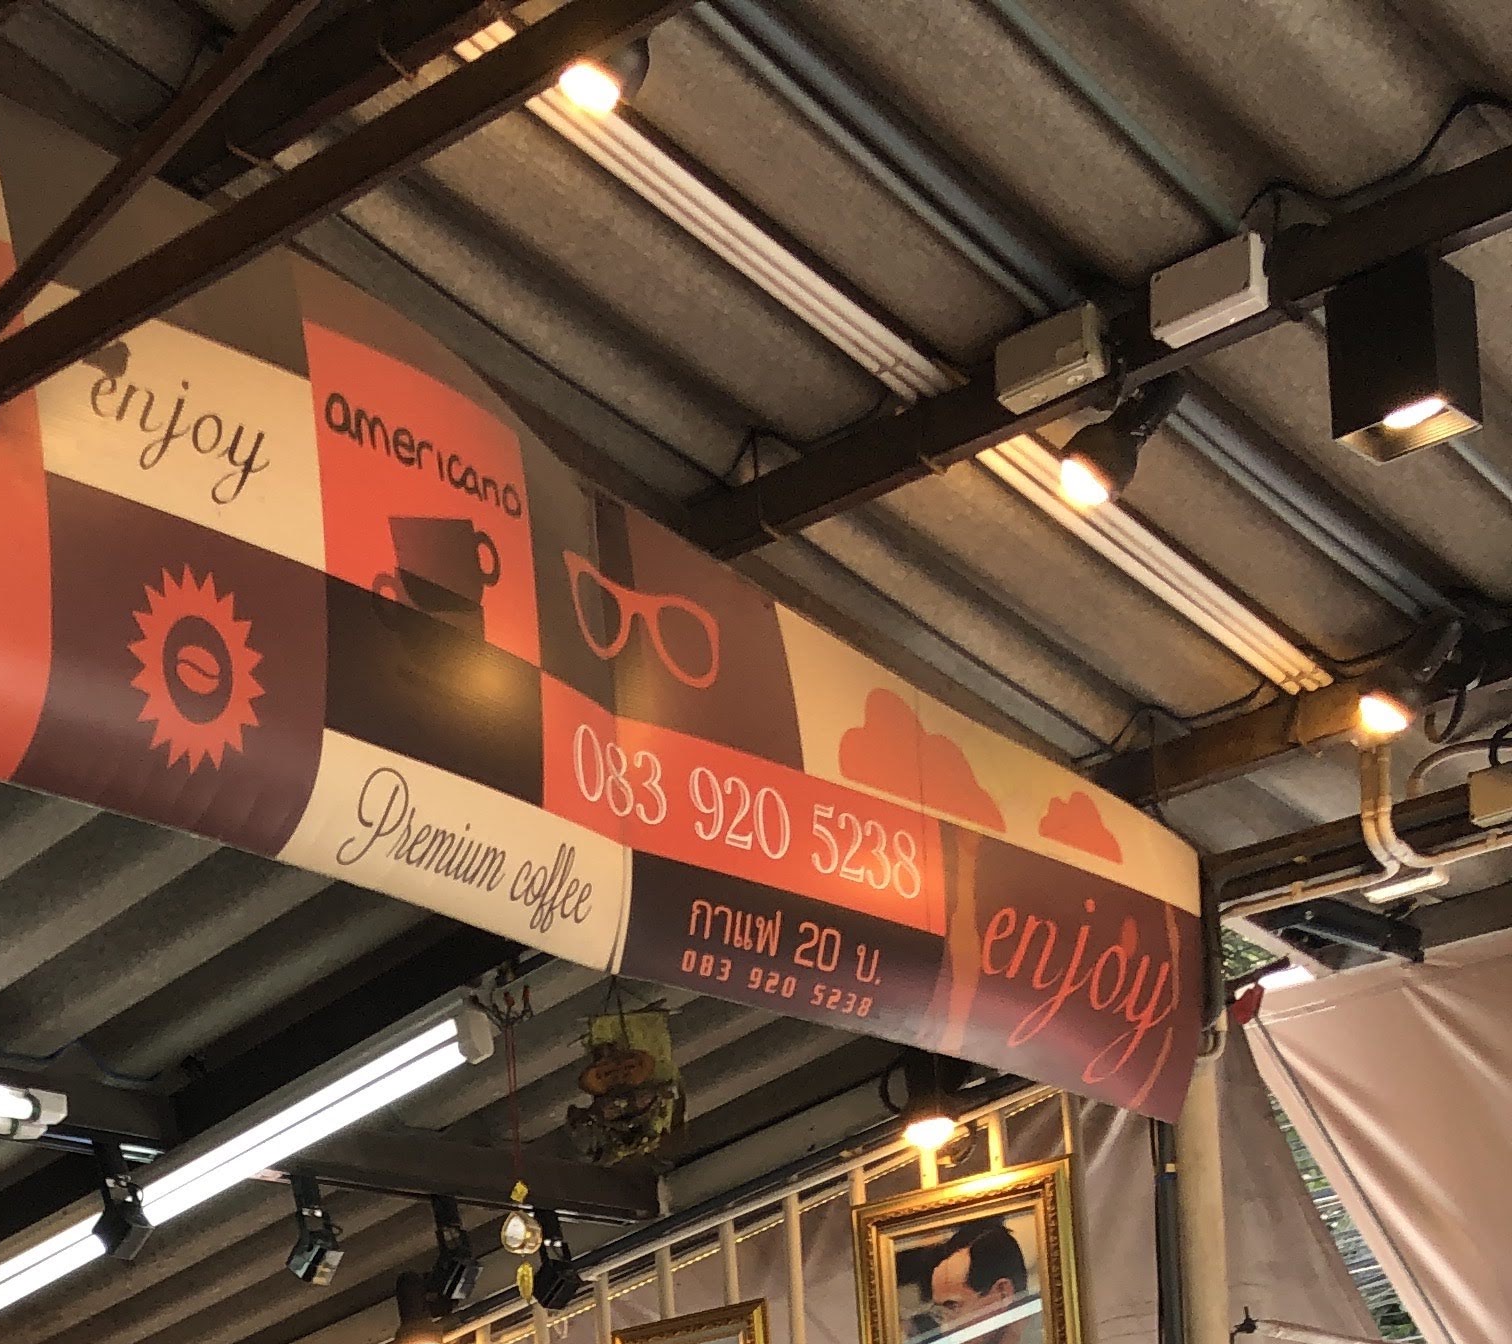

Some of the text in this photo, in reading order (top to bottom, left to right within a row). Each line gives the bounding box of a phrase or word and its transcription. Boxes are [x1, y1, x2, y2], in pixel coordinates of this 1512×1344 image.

[89, 379, 271, 505] enjoy
[324, 391, 524, 519] americano
[335, 765, 594, 929] Premium coffee
[569, 722, 922, 899] 083 920 5238
[680, 948, 875, 1020] 083 920 5238
[689, 895, 781, 960] กาแฟ
[793, 920, 843, 974] 20
[980, 898, 1178, 1085] enjoy
